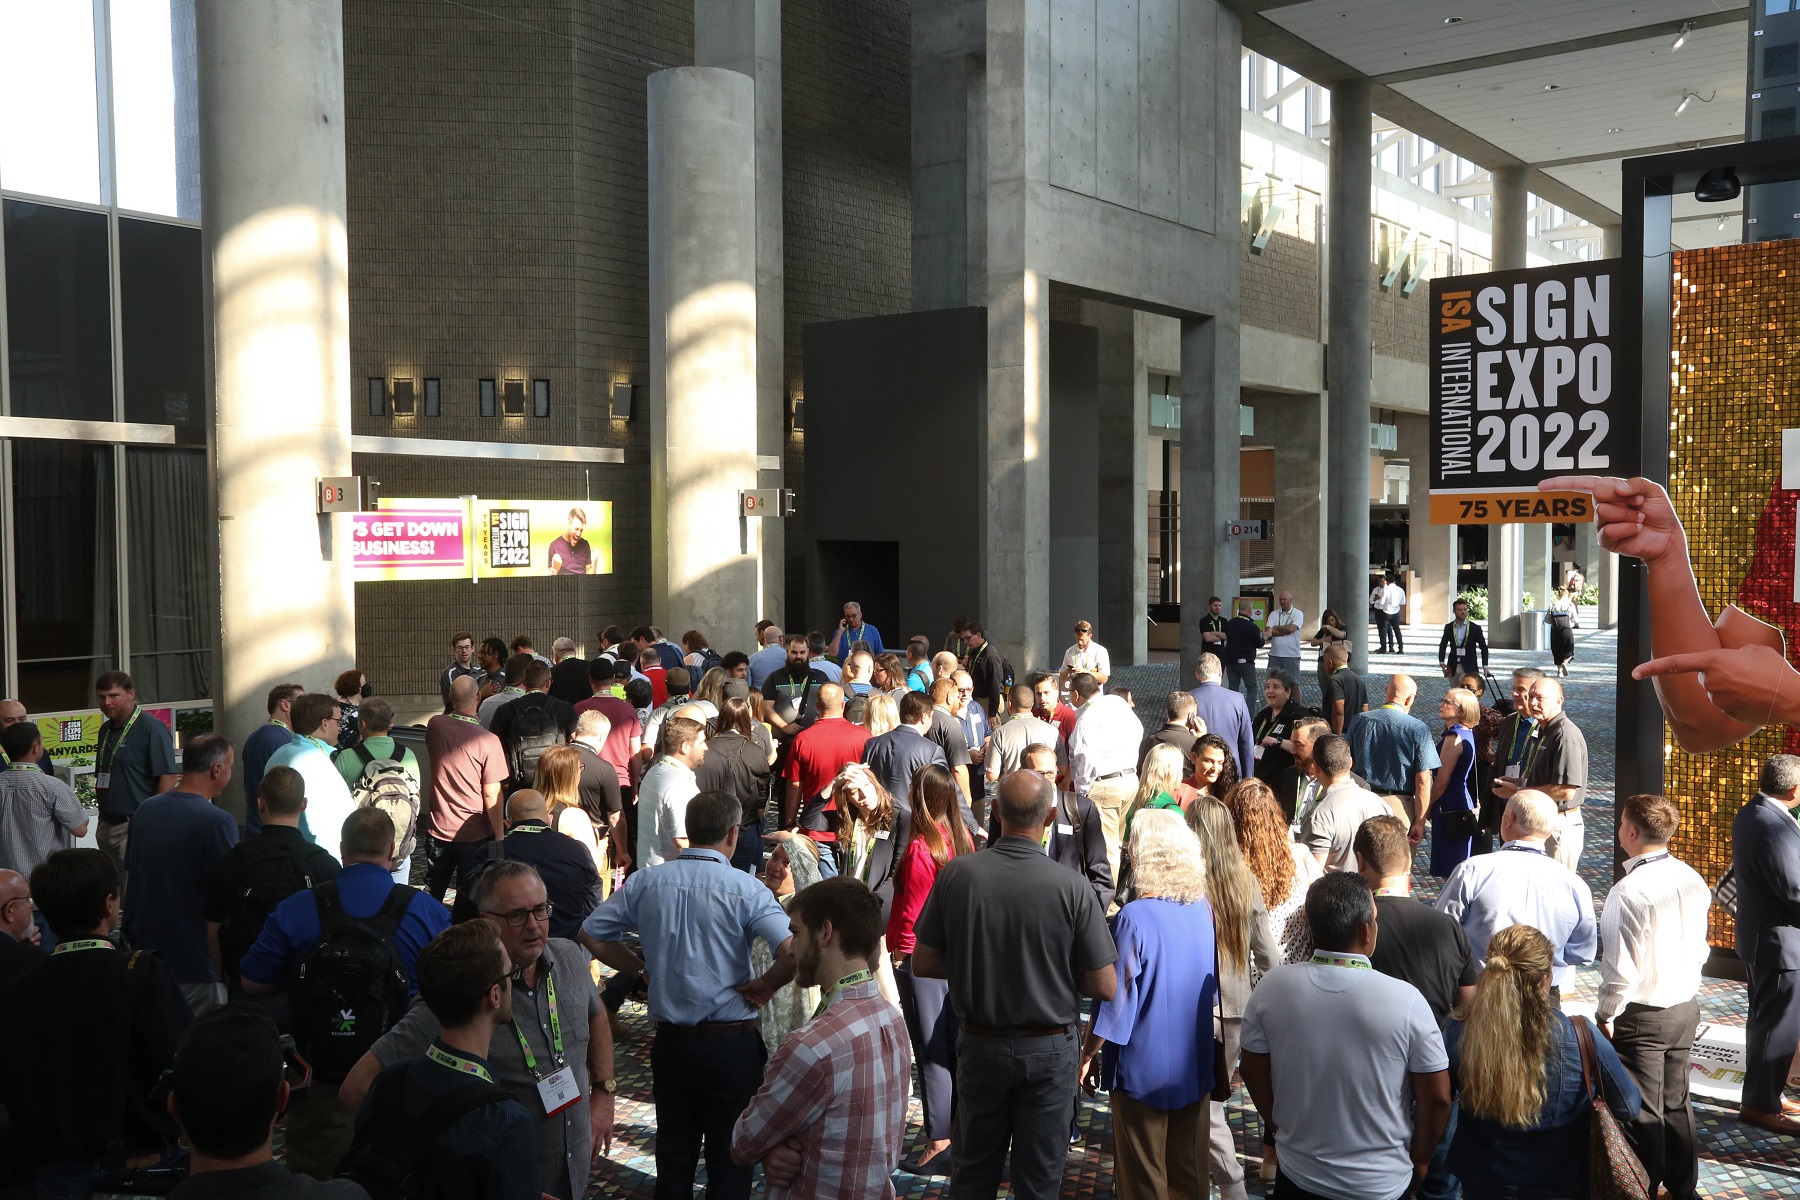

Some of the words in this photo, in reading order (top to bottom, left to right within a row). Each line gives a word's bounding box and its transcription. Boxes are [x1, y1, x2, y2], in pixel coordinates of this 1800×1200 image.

[1441, 290, 1472, 334] ISA
[1476, 274, 1610, 346] SIGN
[1476, 342, 1612, 411] EXPO
[1441, 342, 1472, 480] INTERNATIONAL
[1476, 409, 1610, 473] 2022
[337, 487, 344, 502] 3
[757, 497, 765, 508] 4
[1459, 500, 1488, 519] 75
[1496, 497, 1587, 518] YEARS
[371, 521, 405, 537] GET
[407, 521, 459, 537] DOWN
[499, 511, 529, 530] SIGN
[1243, 526, 1259, 534] 214
[353, 539, 435, 556] BUSINESS!
[499, 530, 529, 548] EXPO
[500, 547, 530, 565] 2022
[67, 721, 81, 729] SIGN
[67, 727, 82, 735] EXPO
[49, 744, 99, 756] ANYARDS
[1692, 1043, 1740, 1054] VIDING
